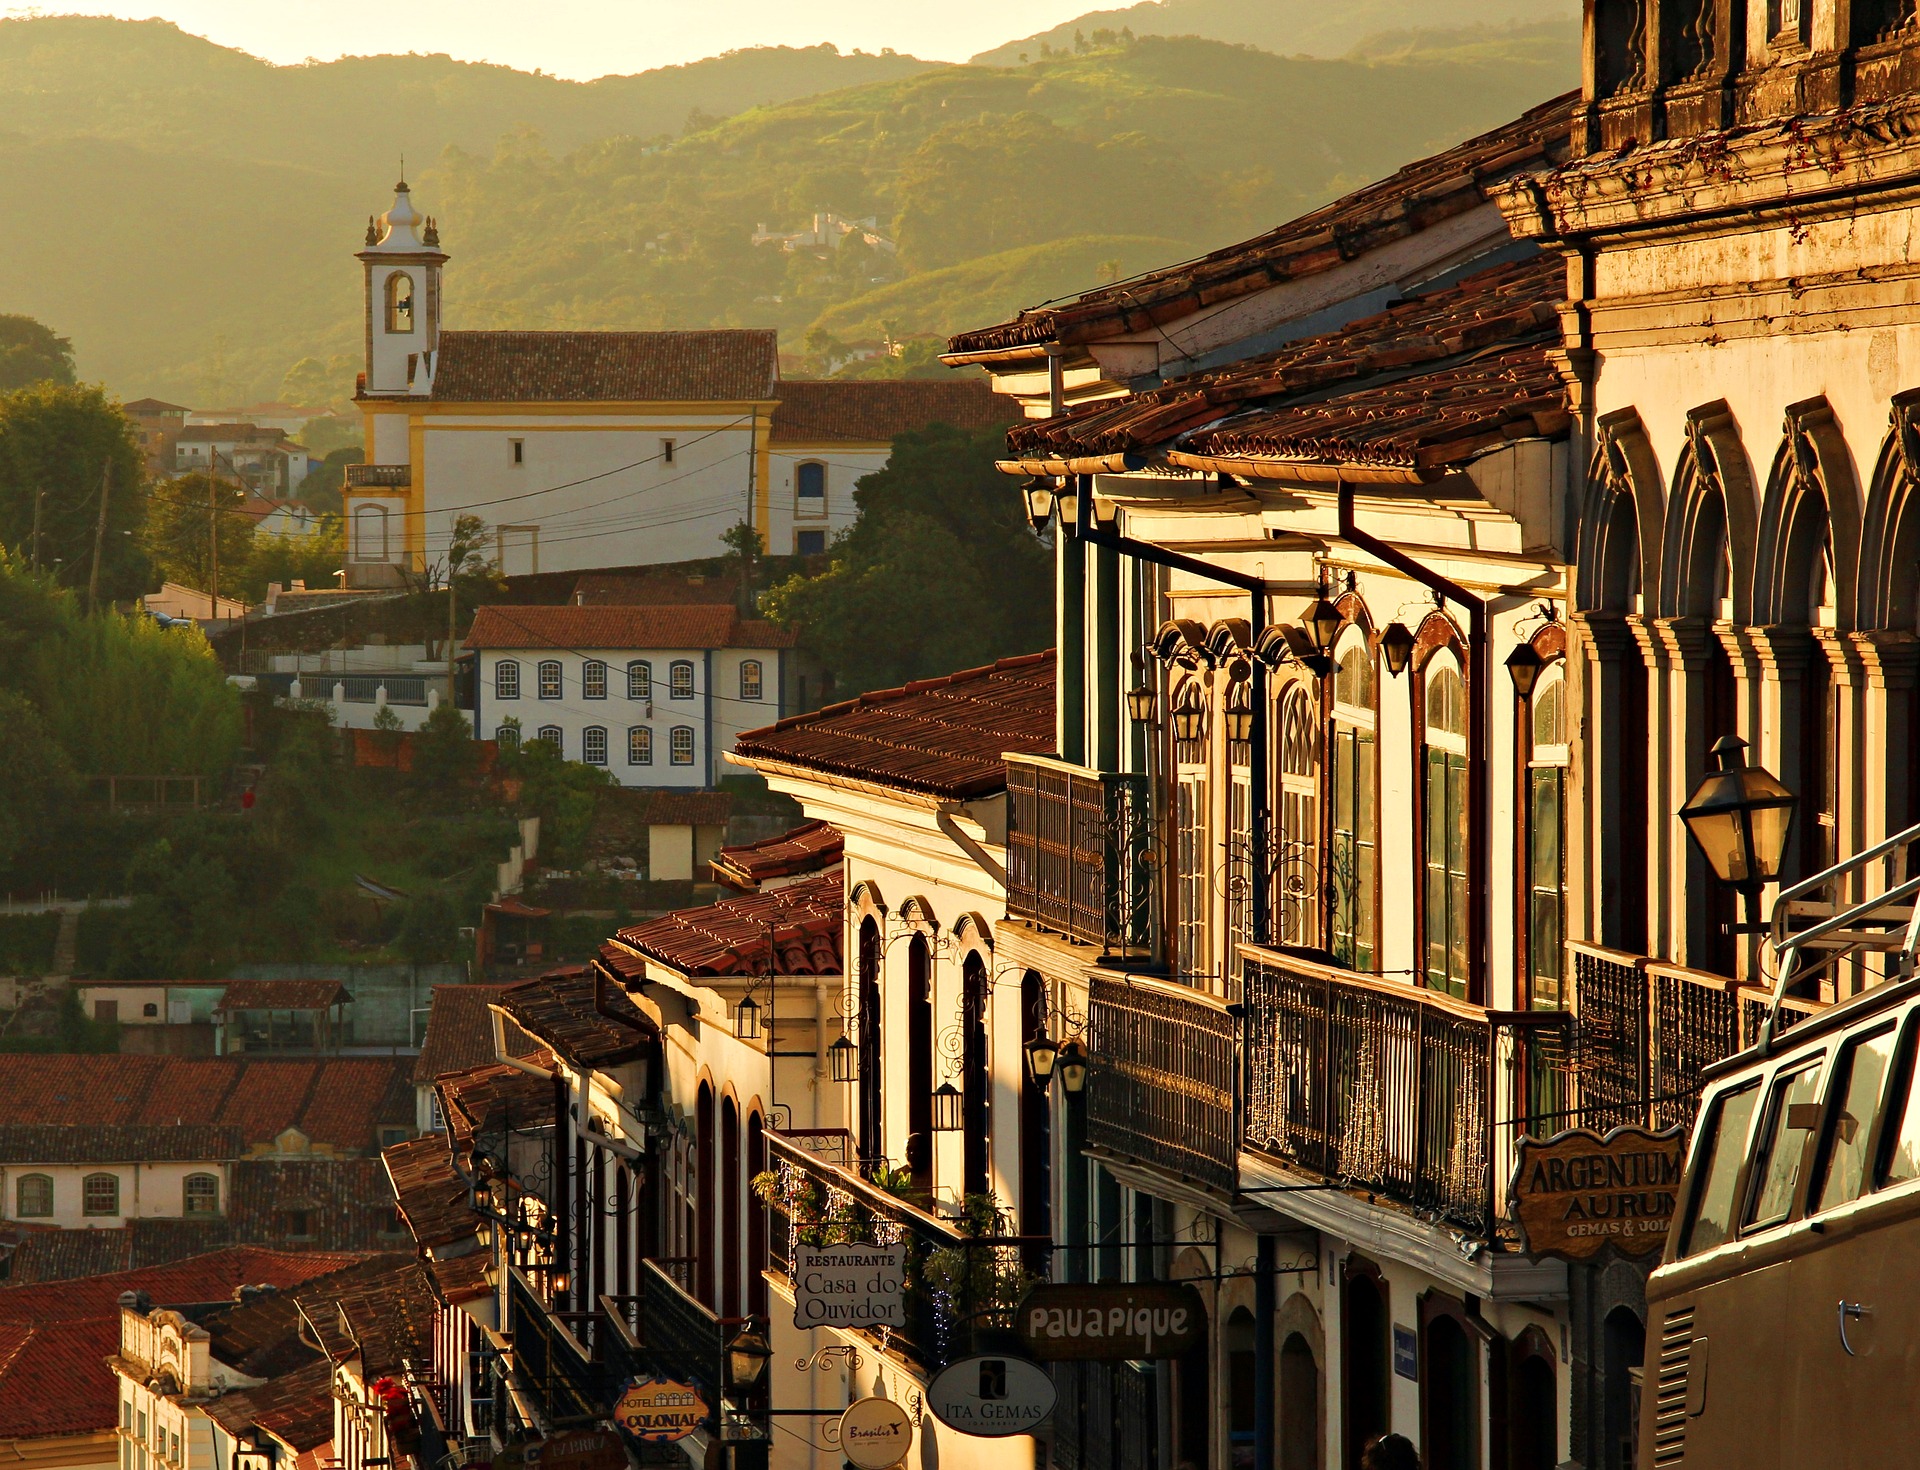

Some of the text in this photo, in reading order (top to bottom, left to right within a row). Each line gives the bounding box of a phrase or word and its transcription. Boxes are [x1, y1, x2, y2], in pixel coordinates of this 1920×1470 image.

[1528, 1151, 1681, 1193] ARGENTUM
[1566, 1222, 1620, 1237] GEMAS
[1622, 1219, 1635, 1237] &
[805, 1255, 896, 1267] RESTAURANTE
[804, 1271, 897, 1295] Casa do
[805, 1296, 897, 1320] Ouvidor
[621, 1398, 655, 1408] HOTEL
[945, 1402, 1042, 1419] ITA GEMAS
[626, 1413, 700, 1428] COLONIAL
[849, 1424, 891, 1439] Brasilis
